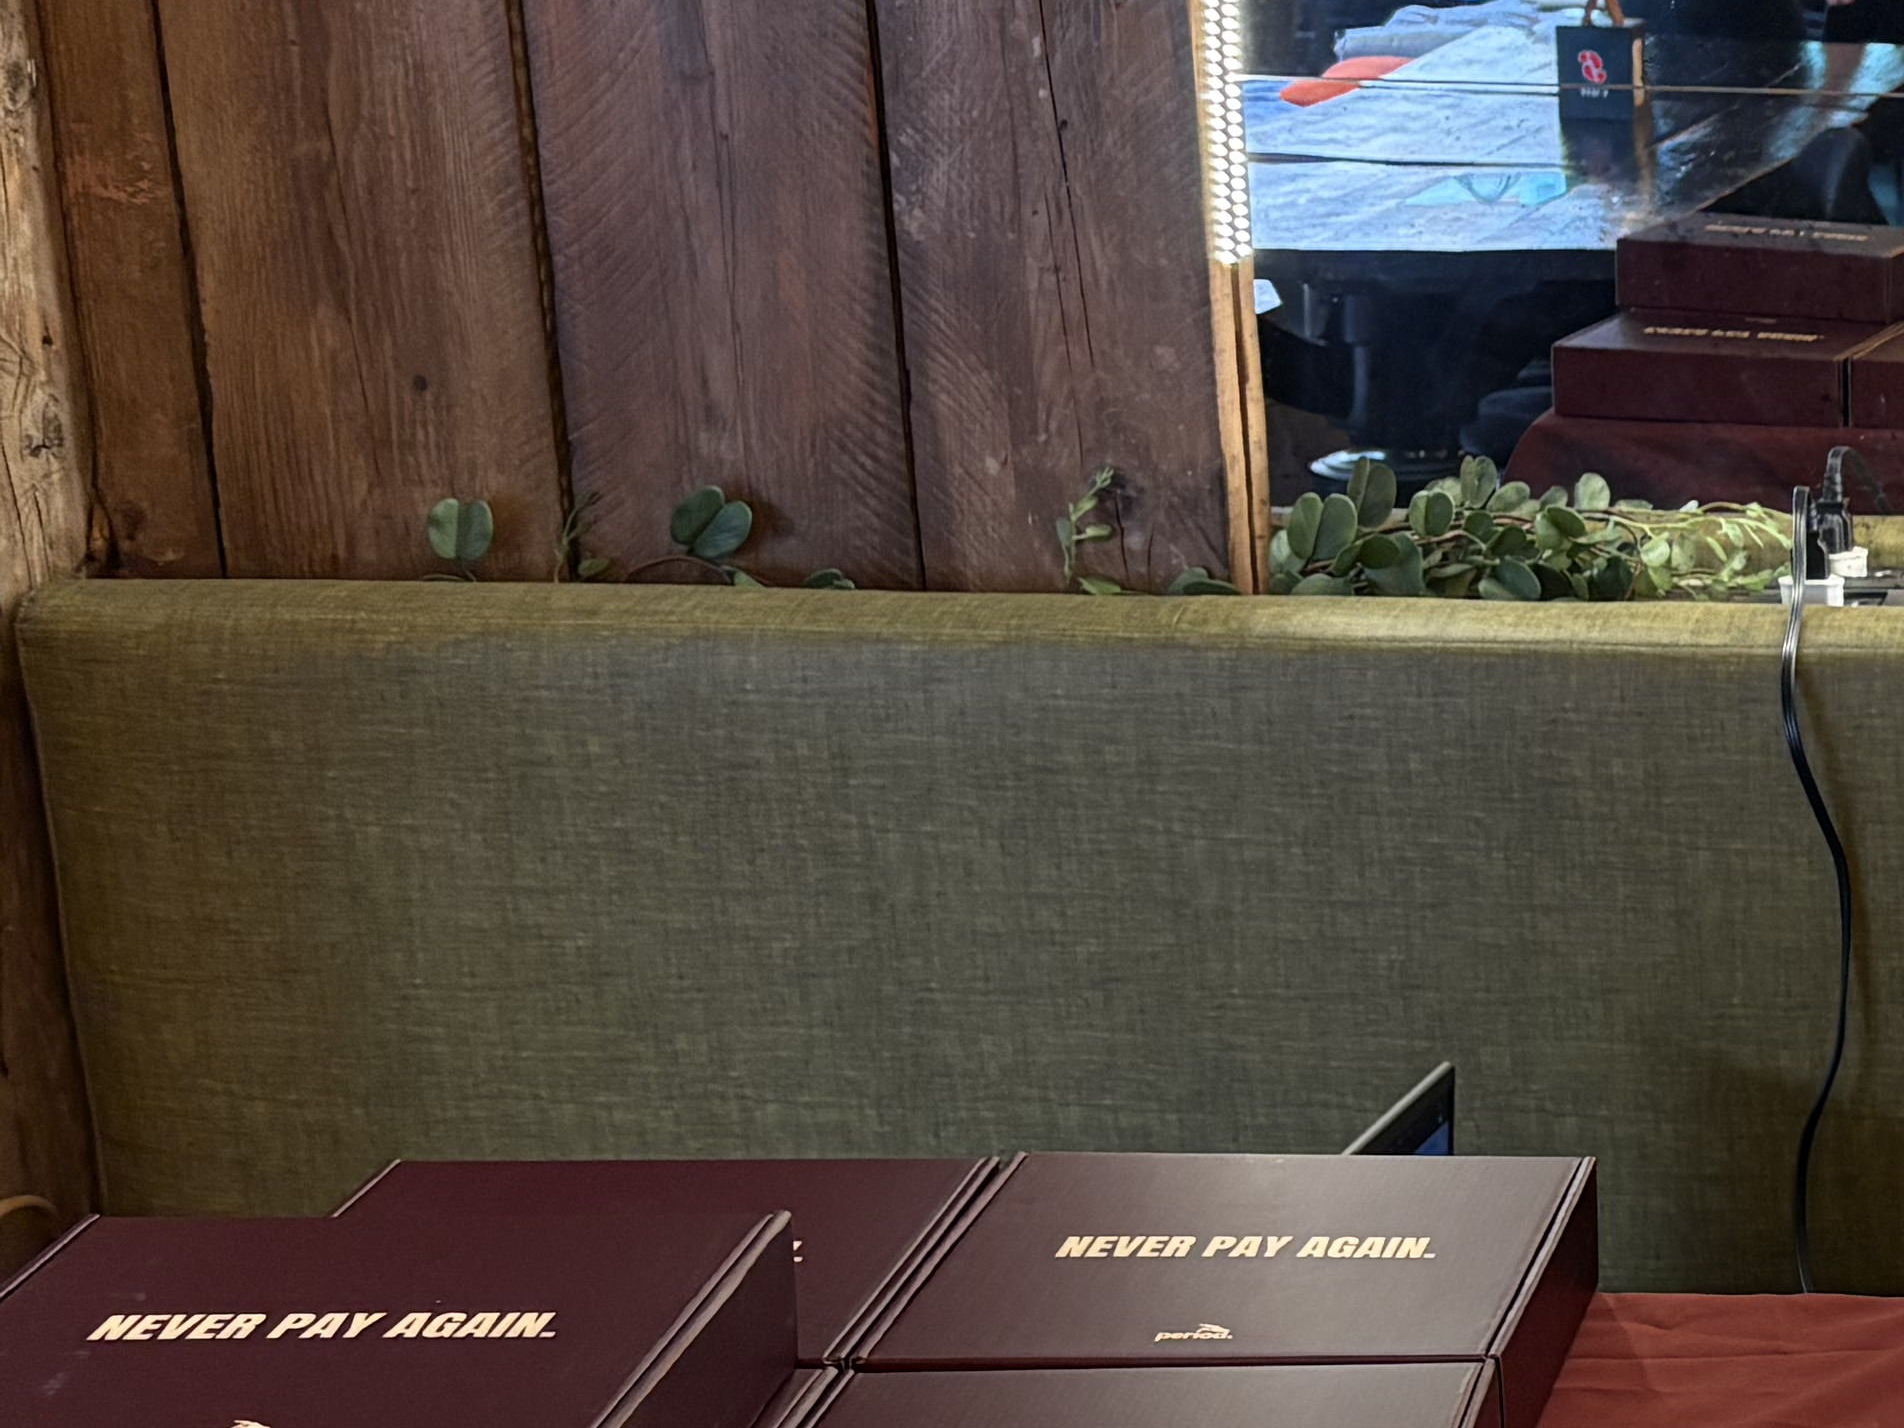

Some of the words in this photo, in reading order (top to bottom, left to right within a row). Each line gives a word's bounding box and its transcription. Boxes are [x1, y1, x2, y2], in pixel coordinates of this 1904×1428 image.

[1055, 1235, 1197, 1258] NEVER
[1201, 1235, 1294, 1258] PAY
[1295, 1236, 1436, 1259] AGAIN.
[86, 1313, 267, 1341] NEVER
[266, 1312, 387, 1339] PAY
[382, 1311, 556, 1338] AGAIN.
[1154, 1328, 1233, 1342] period.
